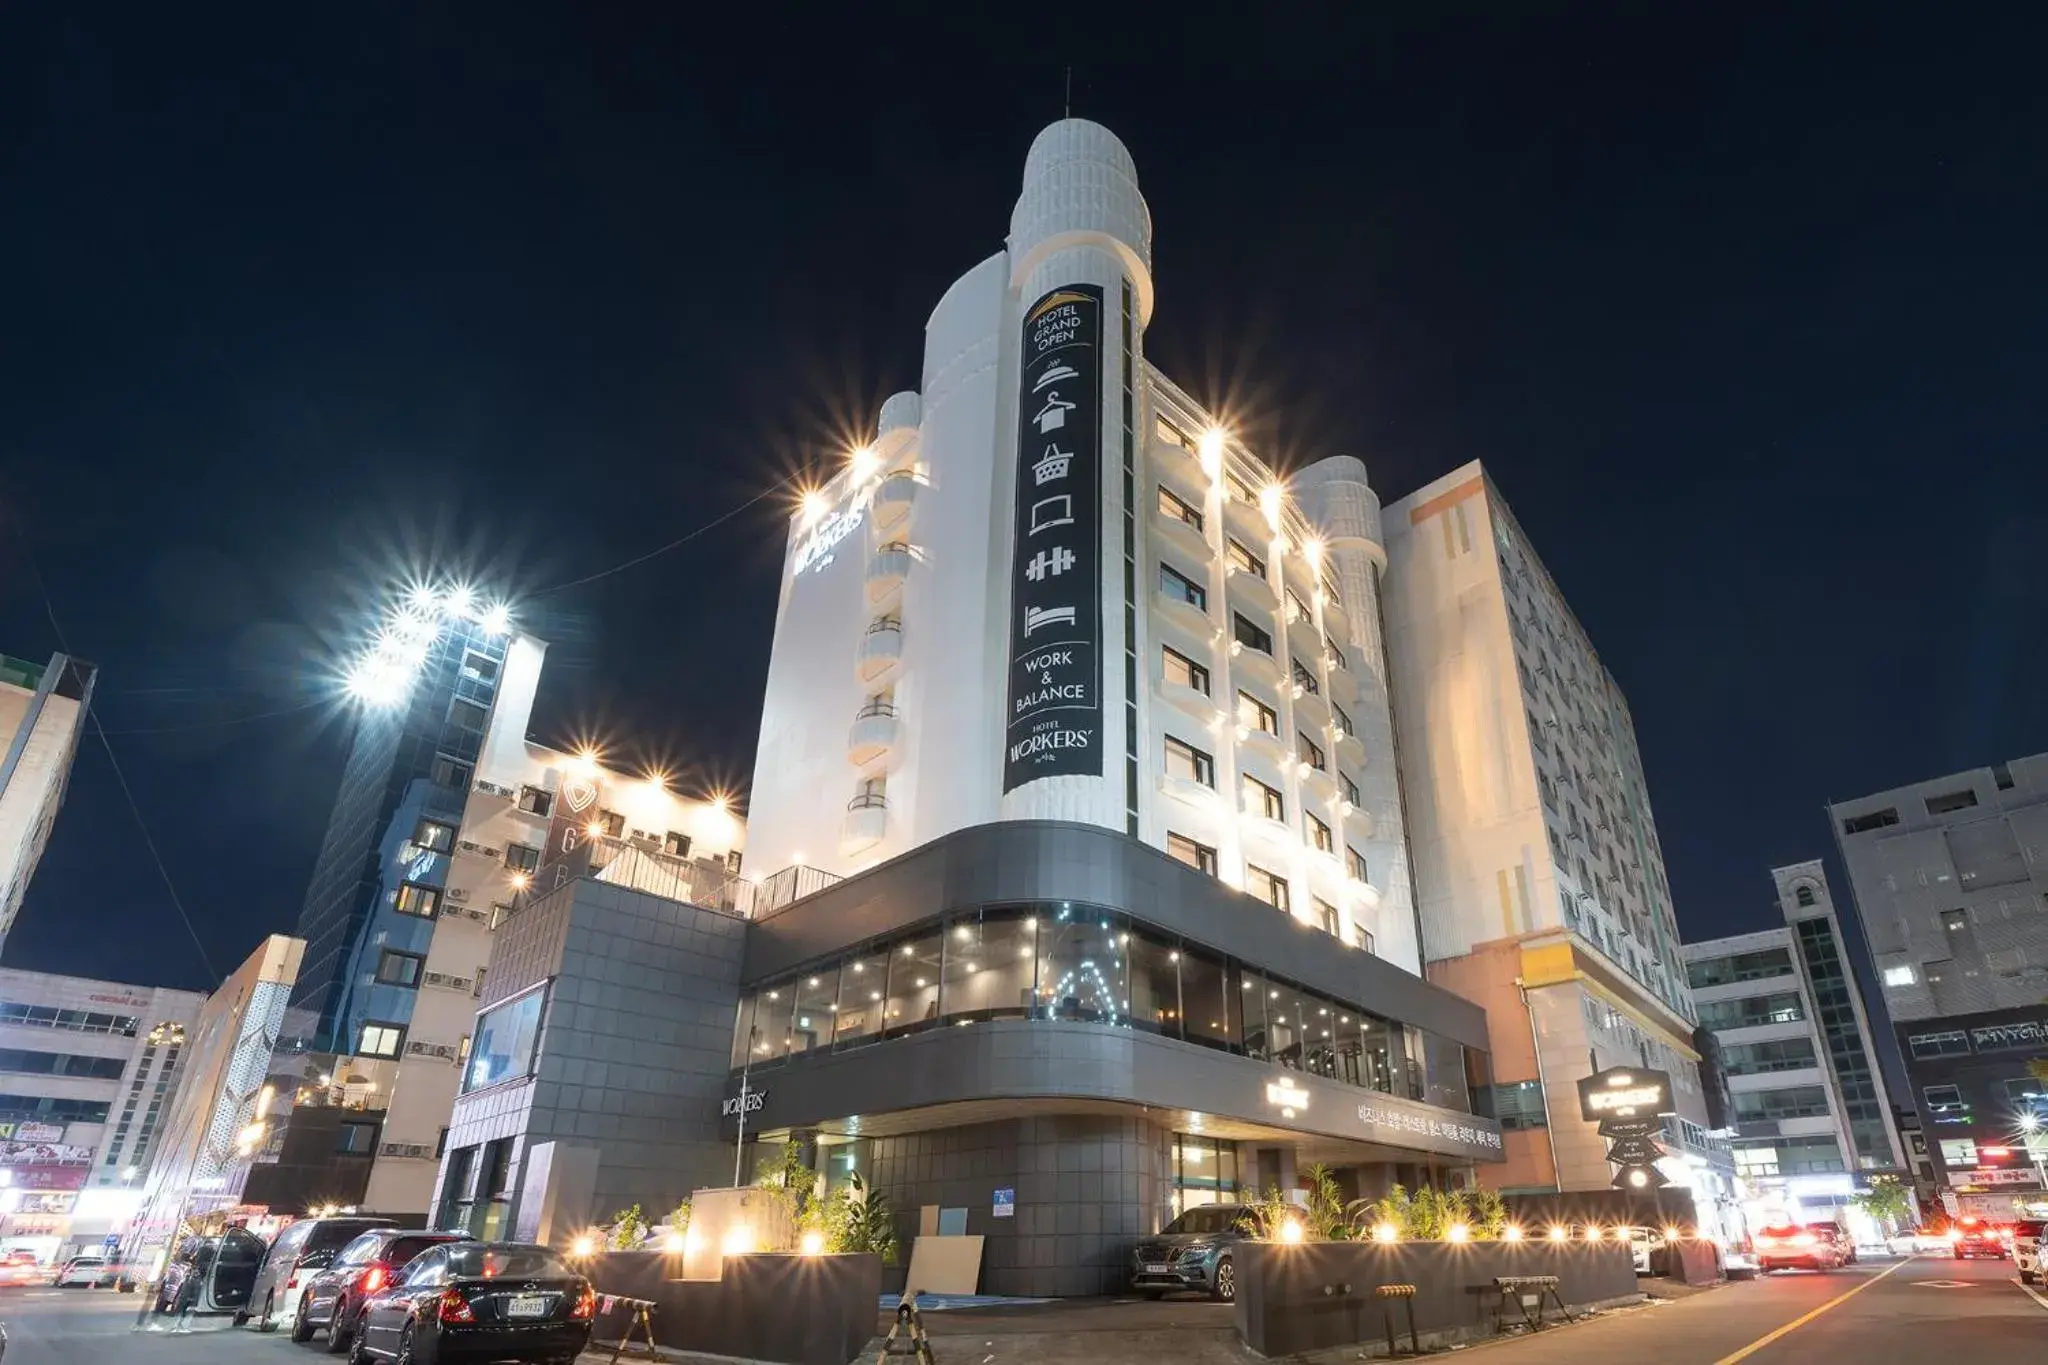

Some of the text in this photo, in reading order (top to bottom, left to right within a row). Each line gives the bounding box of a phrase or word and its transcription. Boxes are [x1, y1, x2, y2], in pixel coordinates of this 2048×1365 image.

[1038, 305, 1077, 328] HOTEL
[1034, 317, 1081, 342] GRAND
[1038, 329, 1074, 351] OPEN
[1024, 651, 1073, 673] WORK
[1041, 671, 1052, 685] &
[1016, 684, 1084, 712] BALANCE
